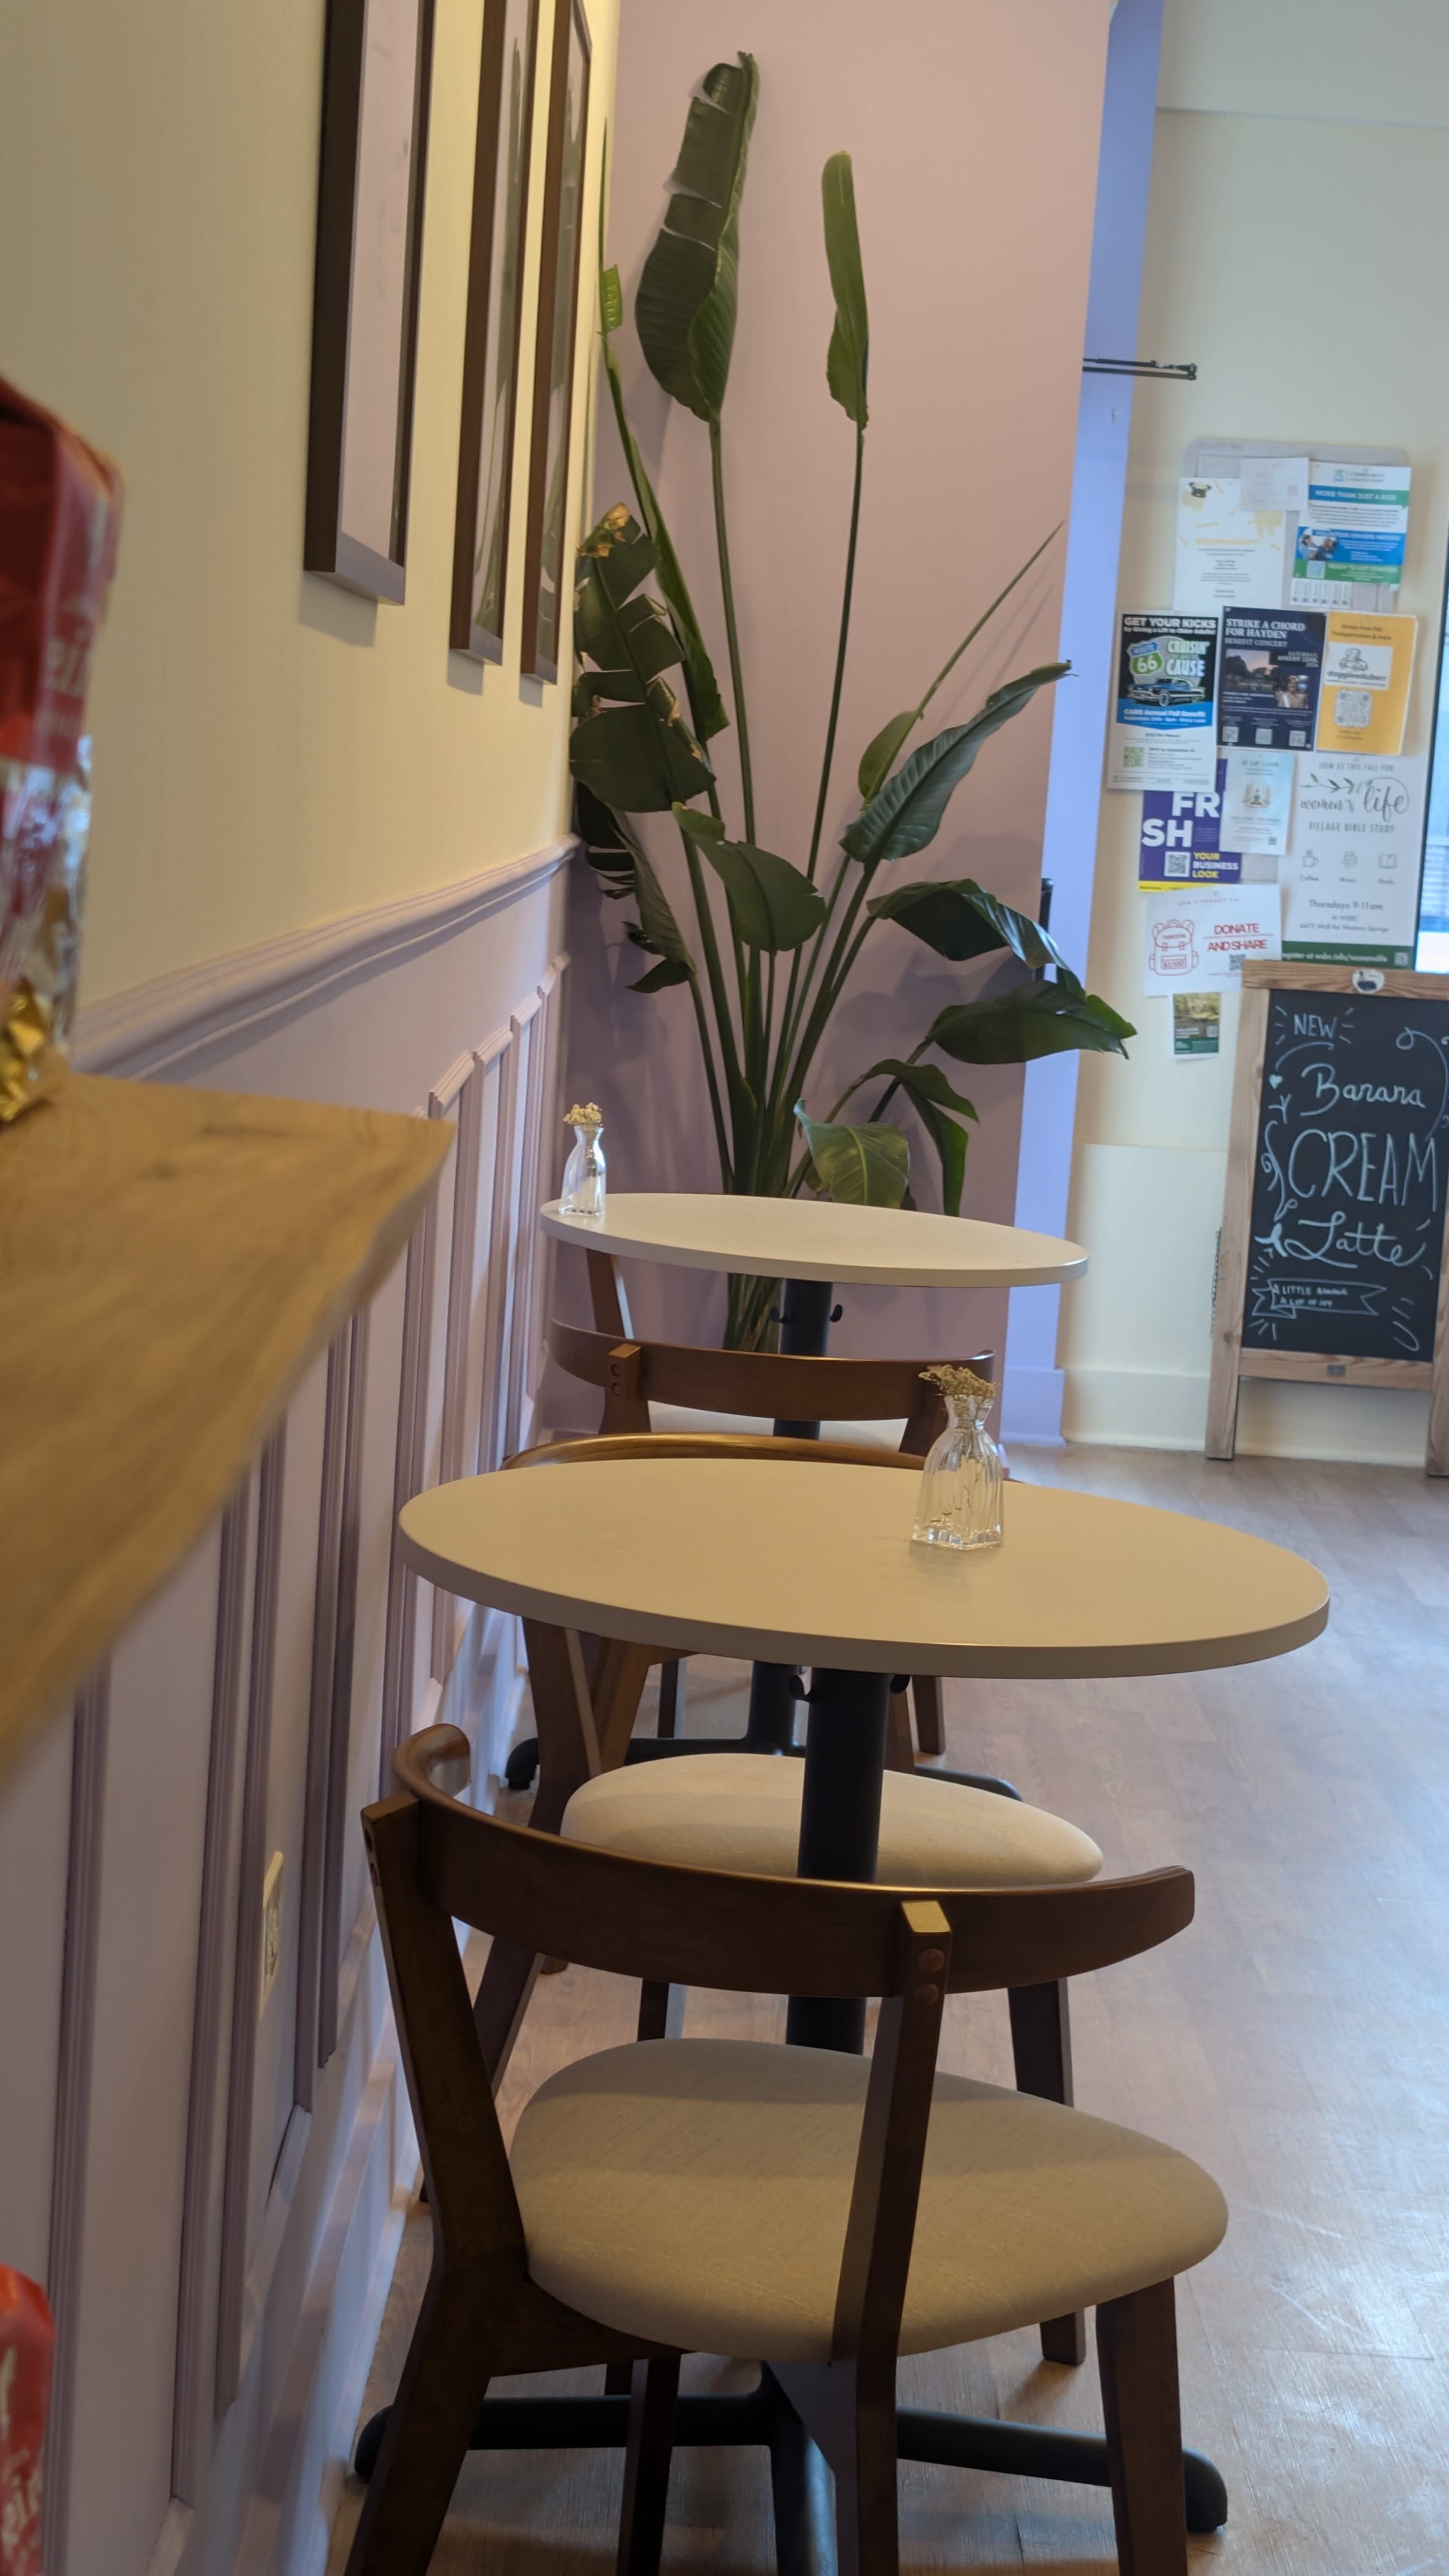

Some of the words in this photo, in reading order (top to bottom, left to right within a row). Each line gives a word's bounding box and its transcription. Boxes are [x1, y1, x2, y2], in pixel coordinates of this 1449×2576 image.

[1124, 617, 1148, 626] GET
[1149, 618, 1181, 627] YOUR
[1182, 619, 1217, 629] KICKS
[1226, 618, 1261, 629] STRIKE
[1261, 621, 1269, 629] A
[1271, 621, 1306, 631] CHORD
[1225, 627, 1245, 637] FOR
[1246, 628, 1288, 639] HAYDEN
[1254, 639, 1288, 647] CONCERT
[1137, 655, 1158, 672] 66
[1166, 659, 1206, 677] CAUSE
[1300, 798, 1354, 813] women's
[1364, 784, 1409, 822] life
[1141, 818, 1193, 847] SH
[1308, 821, 1341, 832] VILLAGE
[1344, 823, 1366, 833] BIBLE
[1370, 824, 1395, 834] STUDY
[1193, 851, 1221, 860] YOUR
[1192, 861, 1239, 870] BUSINESS
[1192, 869, 1220, 878] LOOK
[1309, 899, 1351, 910] Thursdays
[1214, 923, 1260, 935] DONATE
[1207, 941, 1231, 952] AND
[1231, 939, 1268, 950] SHARE
[1294, 1013, 1337, 1038] NEW
[1300, 1063, 1426, 1116] Banana
[1288, 1129, 1436, 1212] CREAM
[1284, 1211, 1426, 1269] Latte
[1283, 1285, 1311, 1295] LITTLE
